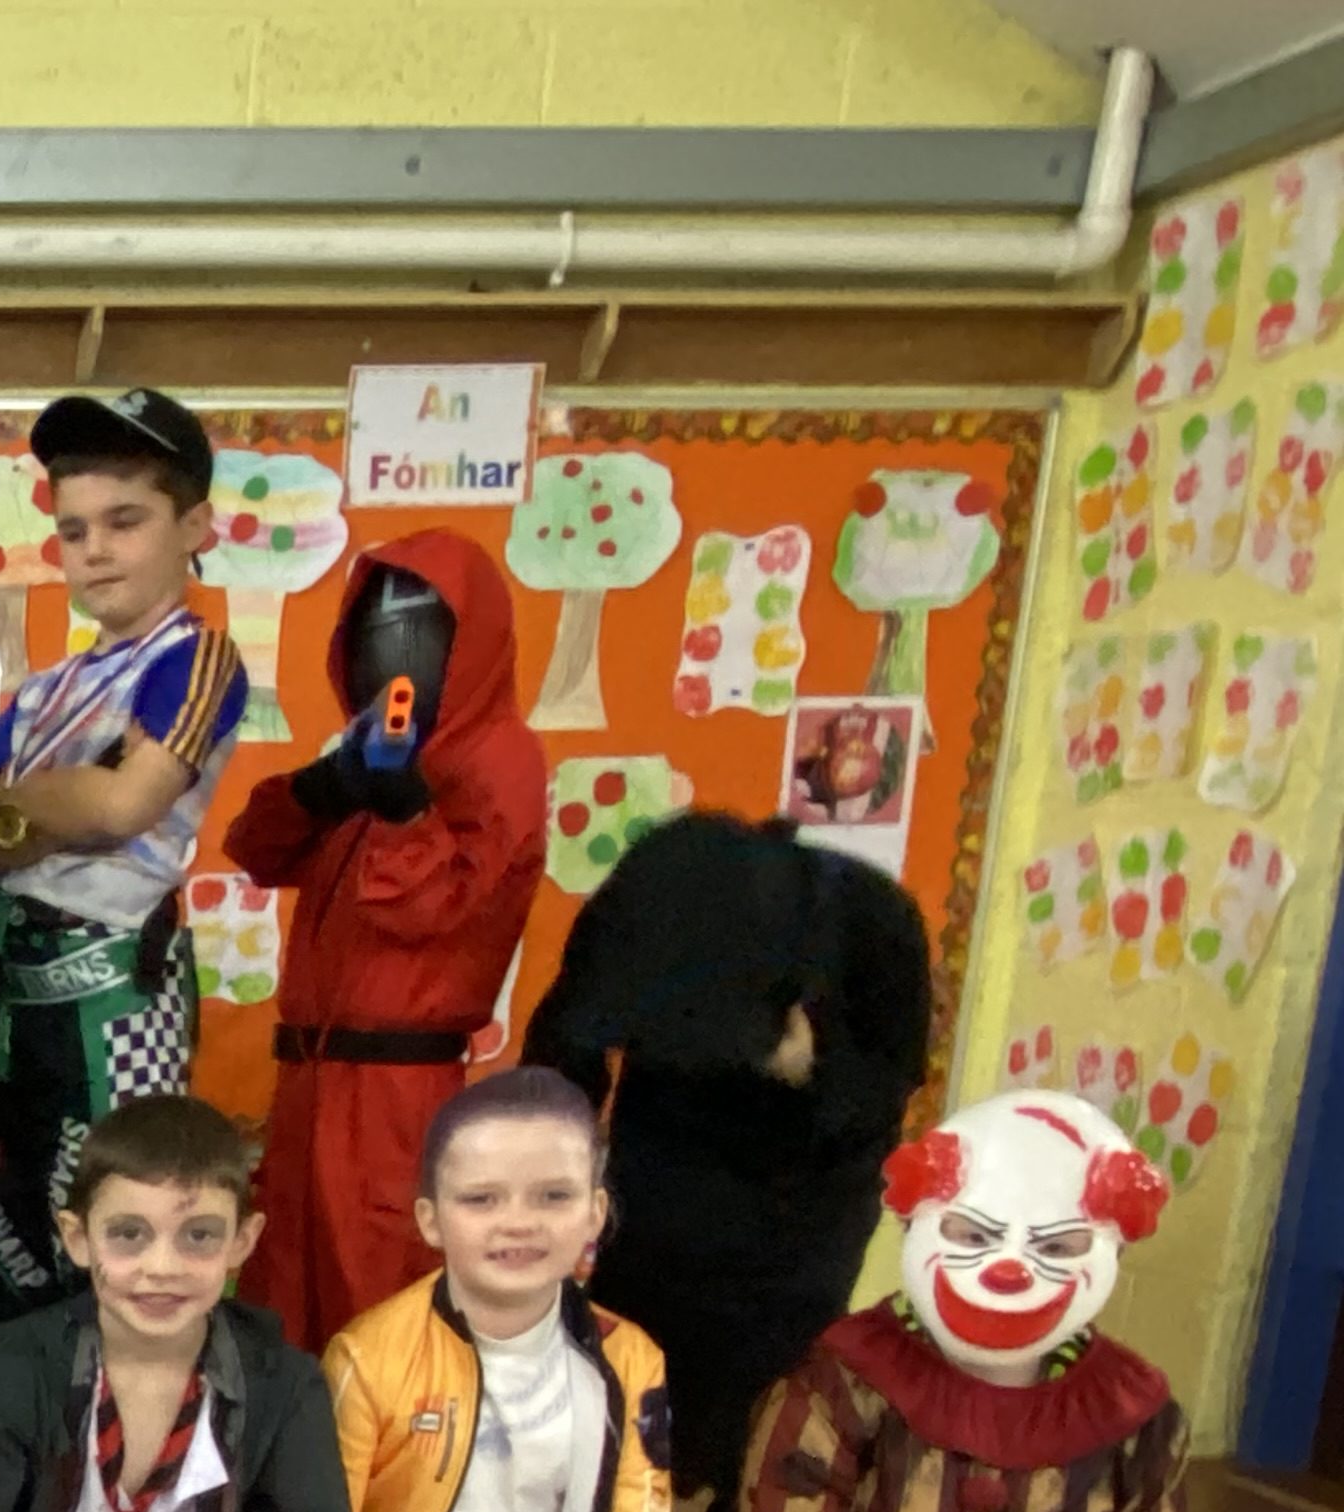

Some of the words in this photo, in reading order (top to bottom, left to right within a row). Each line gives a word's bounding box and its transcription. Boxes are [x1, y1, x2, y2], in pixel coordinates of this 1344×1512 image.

[417, 384, 470, 421] An
[370, 451, 521, 490] Fómhar
[48, 1116, 89, 1211] SHAR
